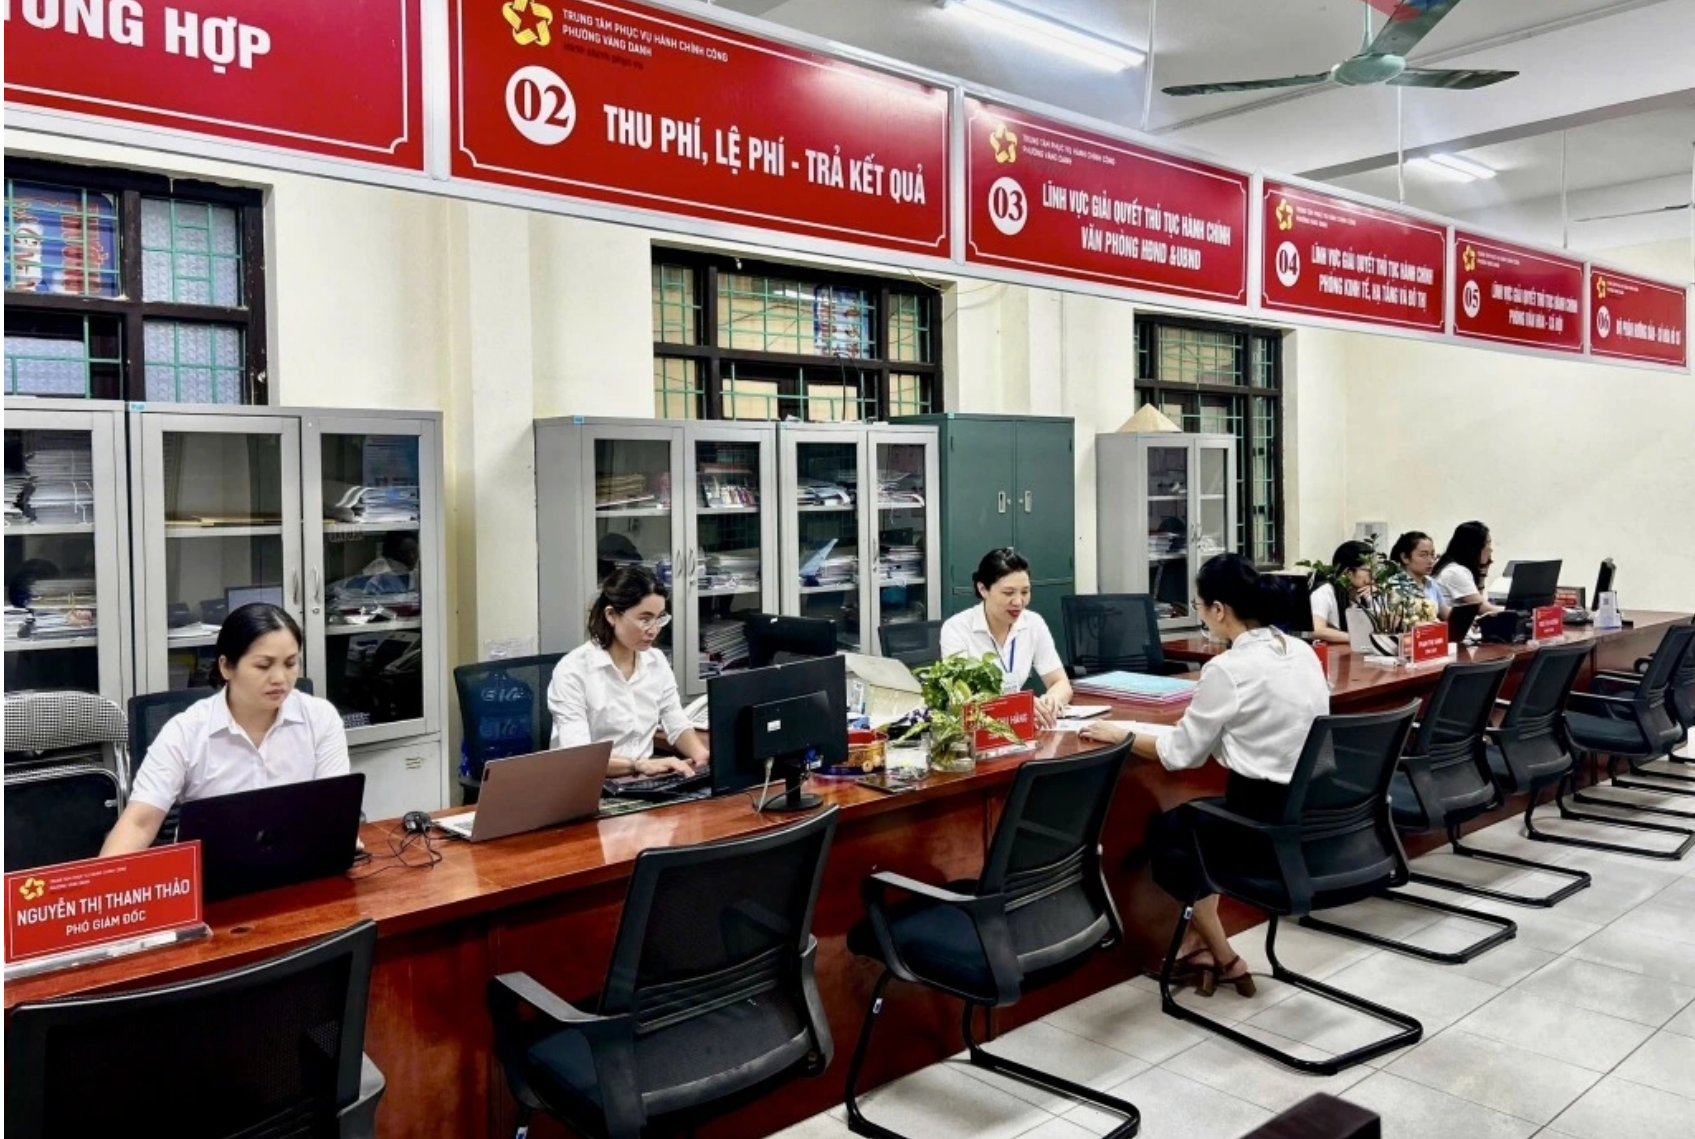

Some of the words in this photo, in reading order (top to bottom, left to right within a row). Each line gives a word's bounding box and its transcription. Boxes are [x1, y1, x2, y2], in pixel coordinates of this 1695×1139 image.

[164, 6, 271, 74] HỢP
[562, 8, 593, 25] TRUNG
[595, 15, 612, 32] TÂM
[615, 23, 639, 40] PHỤC
[640, 29, 653, 45] VỤ
[655, 33, 677, 50] HÀNH
[706, 46, 728, 62] CÔNG
[562, 24, 602, 43] PHƯỜNG
[603, 34, 626, 50] VÀNG
[628, 42, 653, 57] DANH
[514, 78, 569, 128] 02
[603, 104, 652, 149] THU
[661, 117, 708, 166] PHÍ,
[715, 125, 741, 175] LỆ
[749, 135, 784, 177] PHÍ
[791, 161, 799, 169] -
[805, 144, 844, 189] TRẢ
[850, 153, 884, 196] KẾT
[889, 163, 926, 205] QUẢ
[994, 187, 1023, 221] 03
[1043, 180, 1067, 211] LĨNH
[1069, 190, 1089, 219] VỰC
[1092, 190, 1112, 220] GIẢI
[1114, 198, 1143, 227] QUYẾT
[1144, 203, 1161, 231] THỦ
[1163, 211, 1180, 239] TỤC
[1182, 212, 1204, 240] HÀNH
[1206, 219, 1231, 247] CHÍNH
[1081, 223, 1103, 252] VĂN
[1105, 229, 1139, 259] PHÒNG
[1279, 249, 1298, 275] 04
[1465, 287, 1479, 308] 05
[17, 897, 76, 926] NGUYỄN
[79, 895, 103, 915] THỊ
[105, 886, 151, 910] THANH
[155, 877, 190, 899] THẢO
[66, 919, 89, 937] PHÓ
[92, 914, 120, 931] GIÁM
[122, 909, 146, 925] ĐỐC
